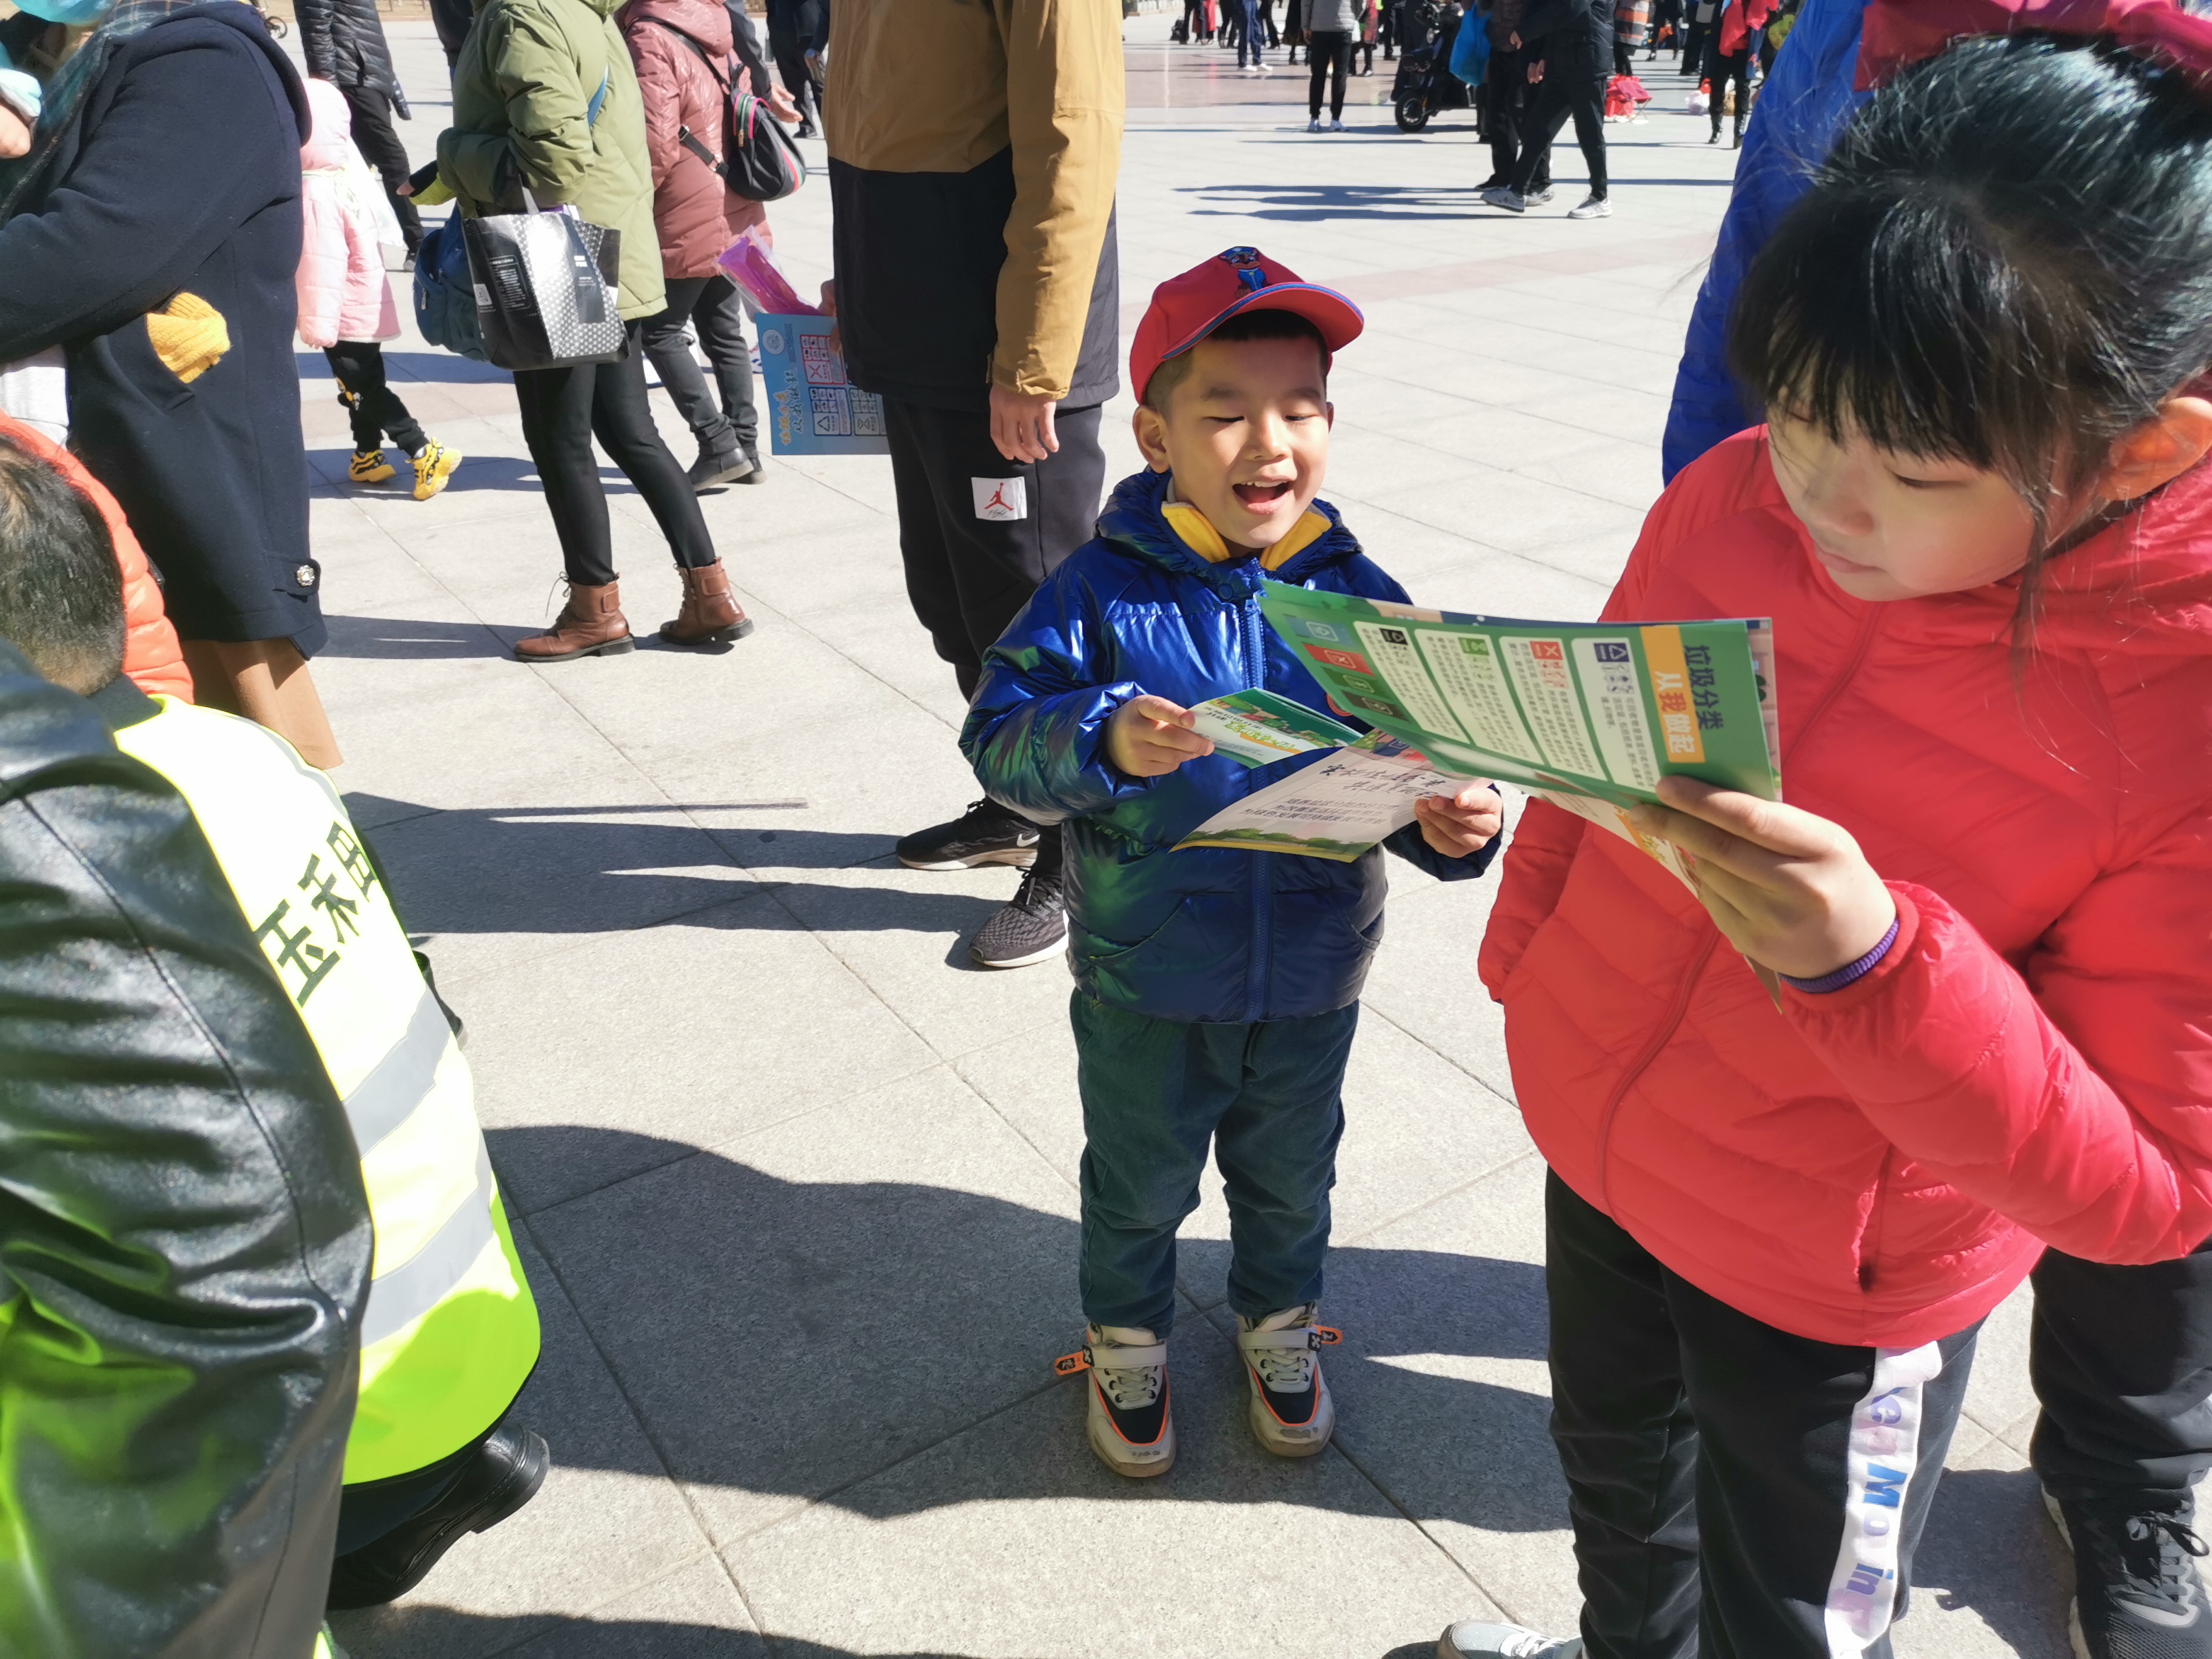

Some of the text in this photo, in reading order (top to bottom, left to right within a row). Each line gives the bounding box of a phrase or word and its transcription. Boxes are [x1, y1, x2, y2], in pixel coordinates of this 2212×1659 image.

[1654, 671, 1695, 754] 从我做起
[1684, 645, 1724, 731] 垃圾分类
[253, 820, 377, 1008] 玉禾田
